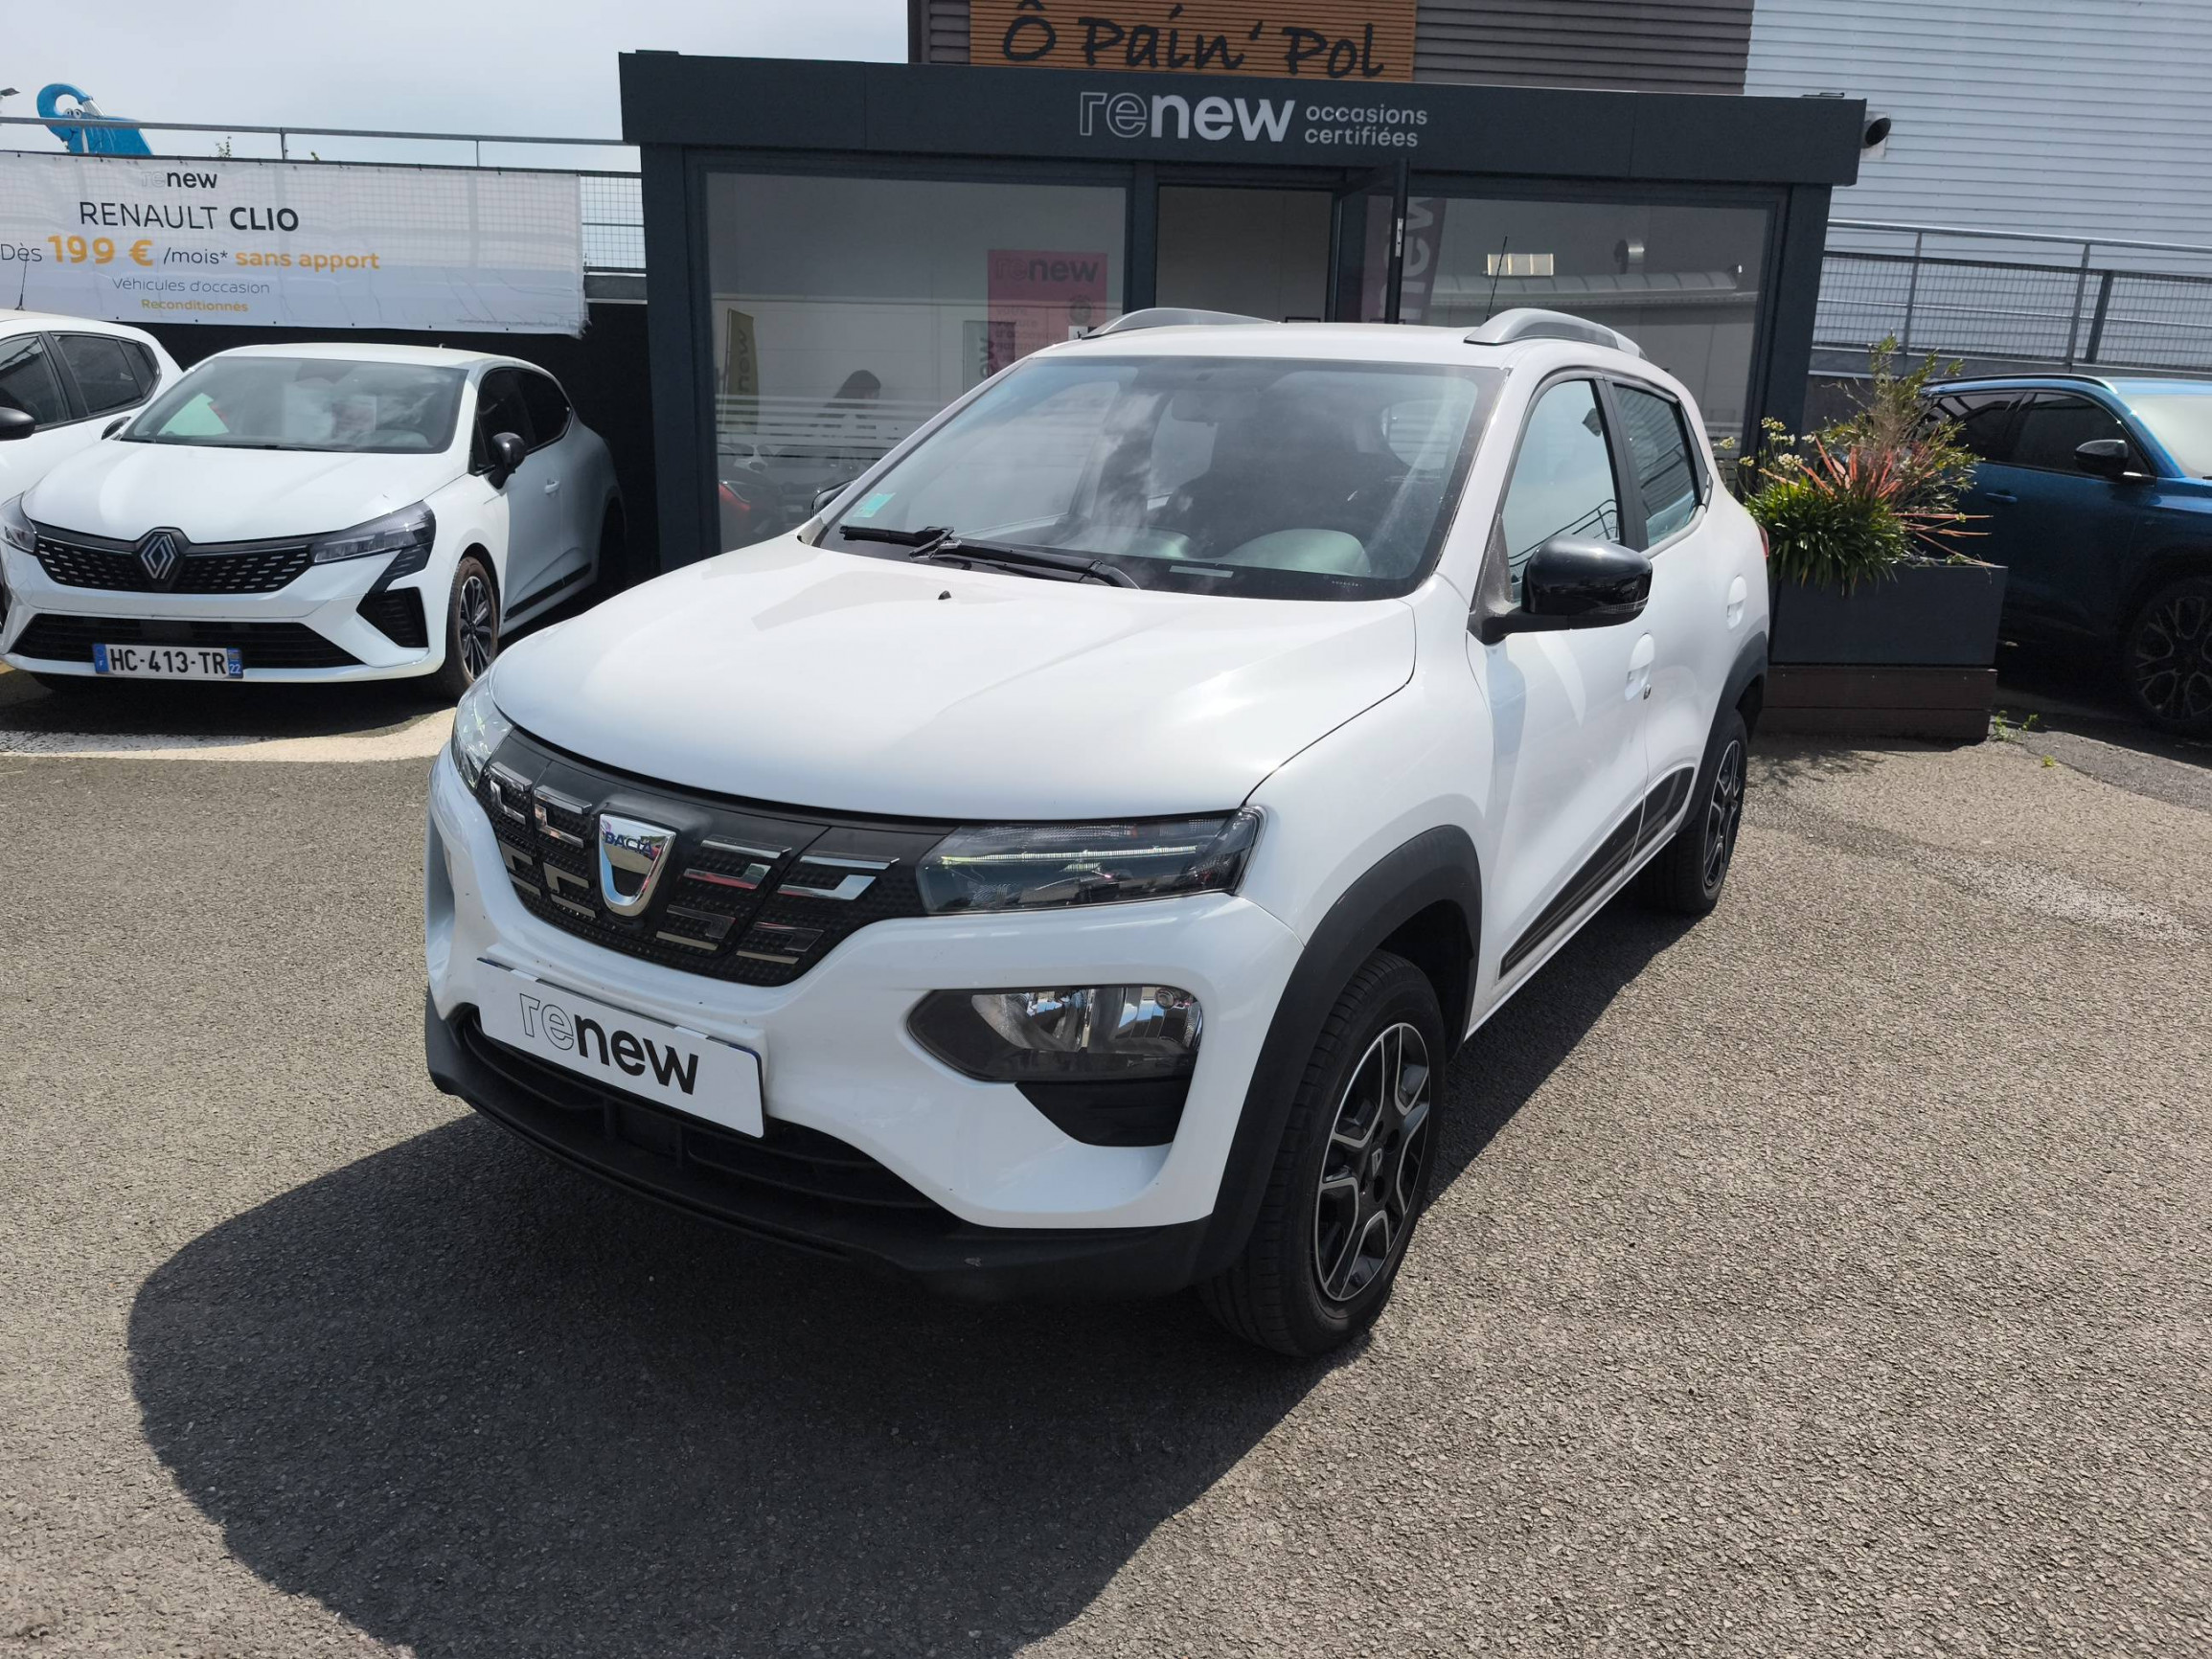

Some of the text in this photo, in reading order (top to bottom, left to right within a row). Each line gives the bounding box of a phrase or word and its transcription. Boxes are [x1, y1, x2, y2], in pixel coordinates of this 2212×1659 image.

[1004, 0, 1056, 61] Ô
[1282, 22, 1384, 78] Pol
[1079, 91, 1295, 143] renew
[1306, 102, 1428, 126] occasions
[1304, 125, 1419, 148] certifiées
[141, 170, 218, 190] renew
[80, 201, 299, 232] RENAULT CLIO
[1, 242, 43, 262] Dès
[48, 235, 116, 265] 199
[128, 239, 154, 267] €
[235, 251, 292, 267] sans
[299, 252, 380, 273] apport
[995, 259, 1100, 284] renew
[190, 280, 270, 294] d'occasion
[109, 648, 227, 674] HC-413-TR
[229, 663, 241, 674] 22
[604, 830, 655, 856] DACIA
[520, 992, 699, 1096] renew
